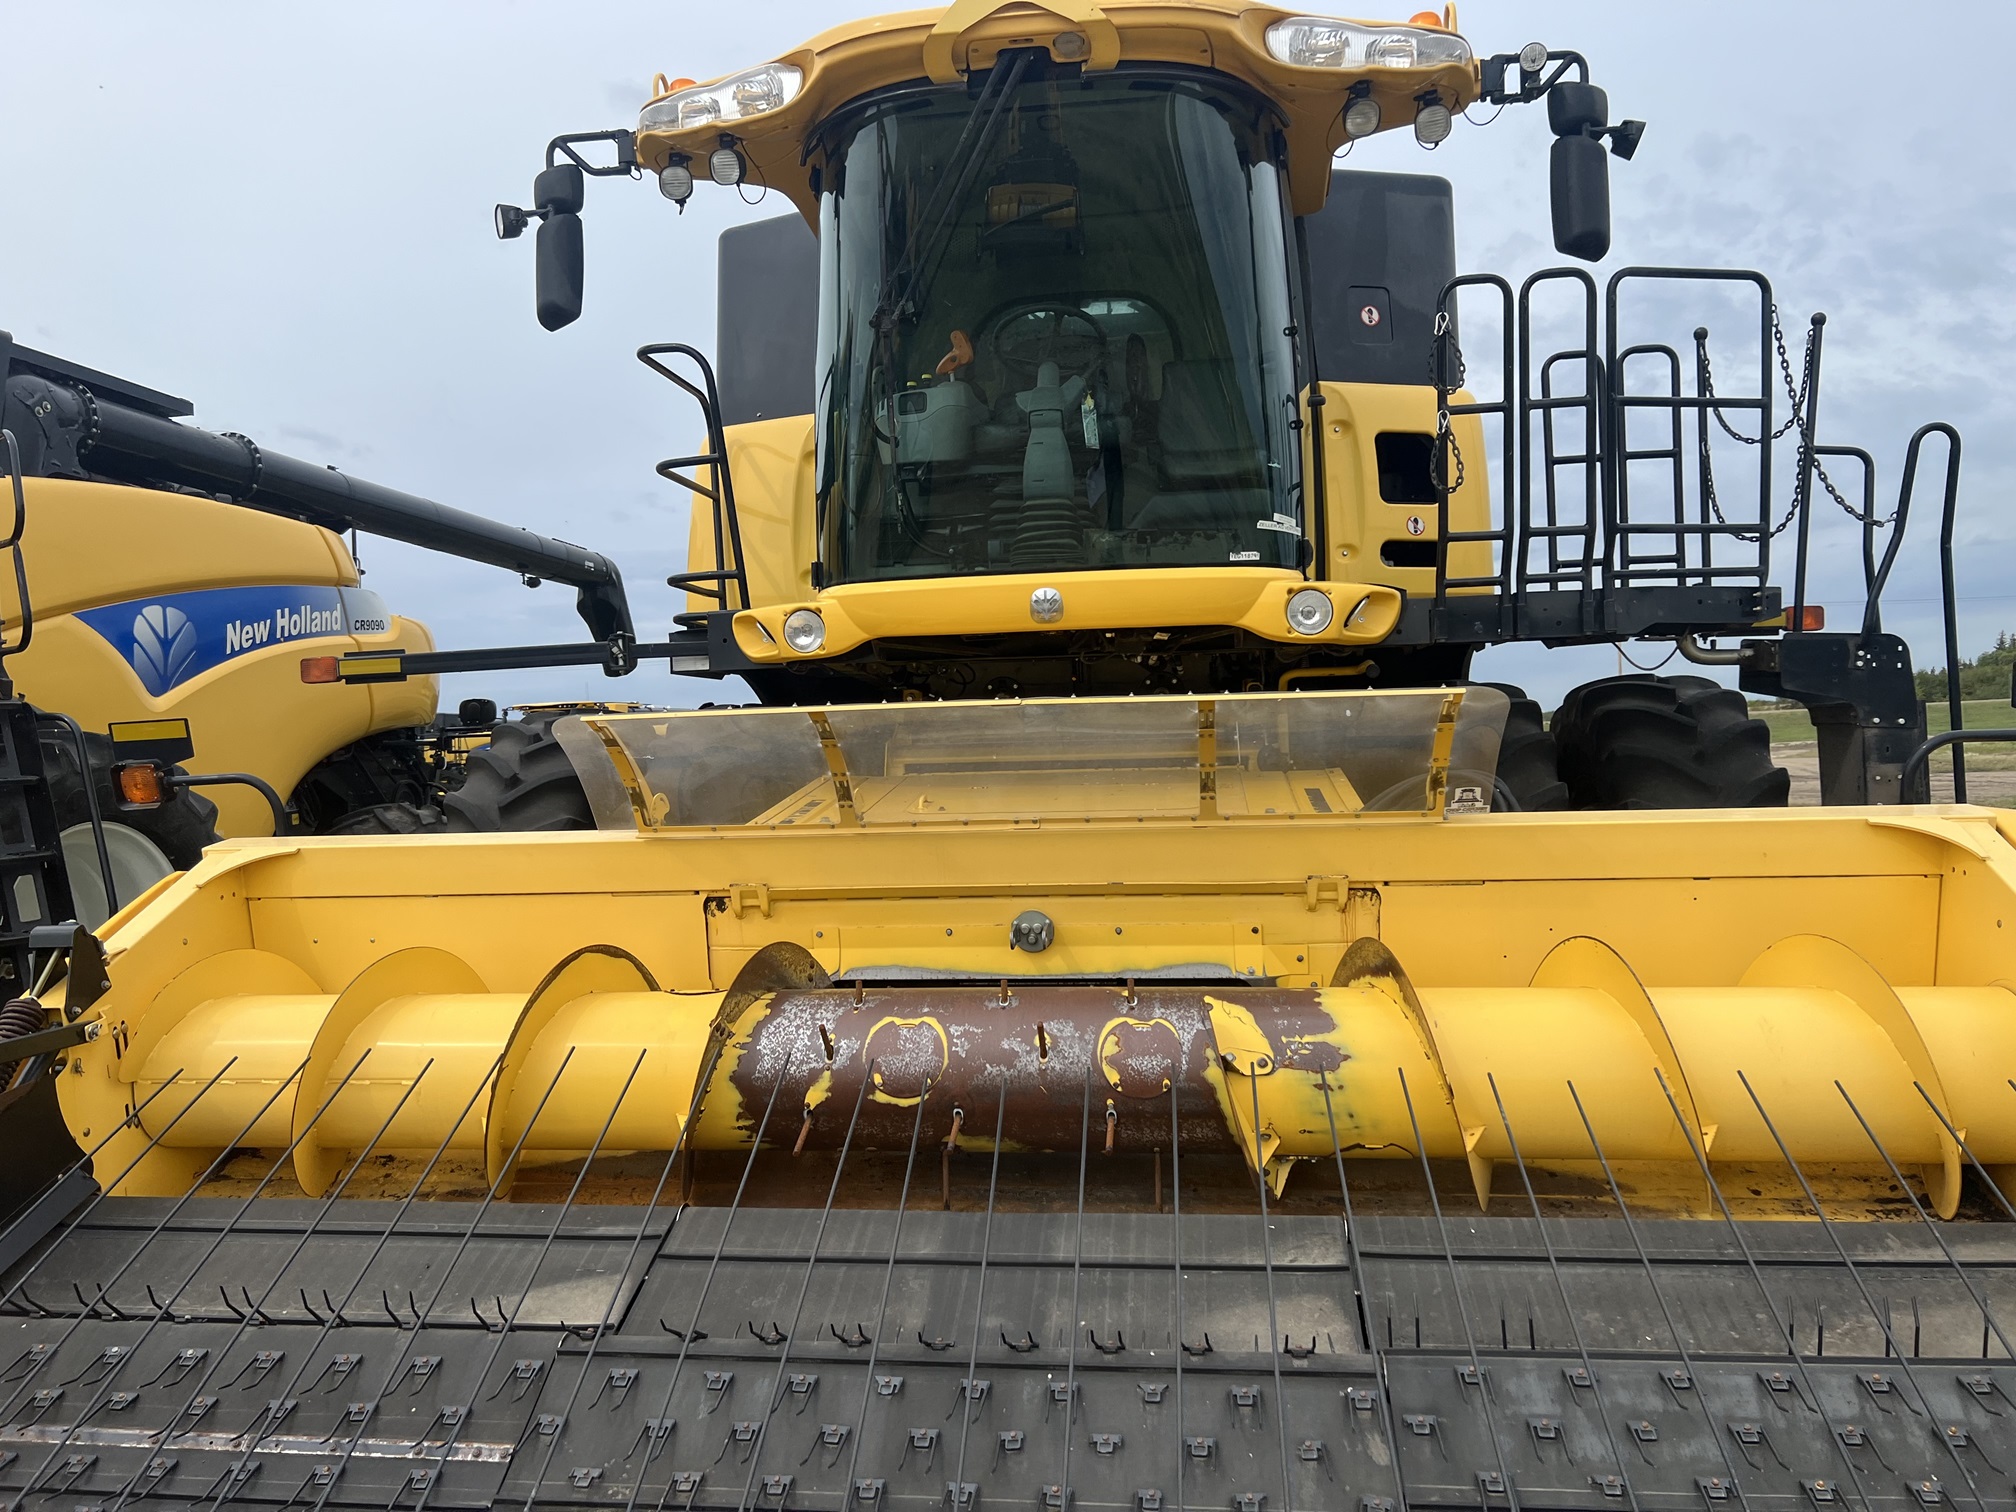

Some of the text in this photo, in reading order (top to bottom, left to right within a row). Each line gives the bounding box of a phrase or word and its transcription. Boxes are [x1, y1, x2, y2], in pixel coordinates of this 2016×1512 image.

[226, 603, 342, 655] New Holland
[354, 618, 385, 631] CR9090
